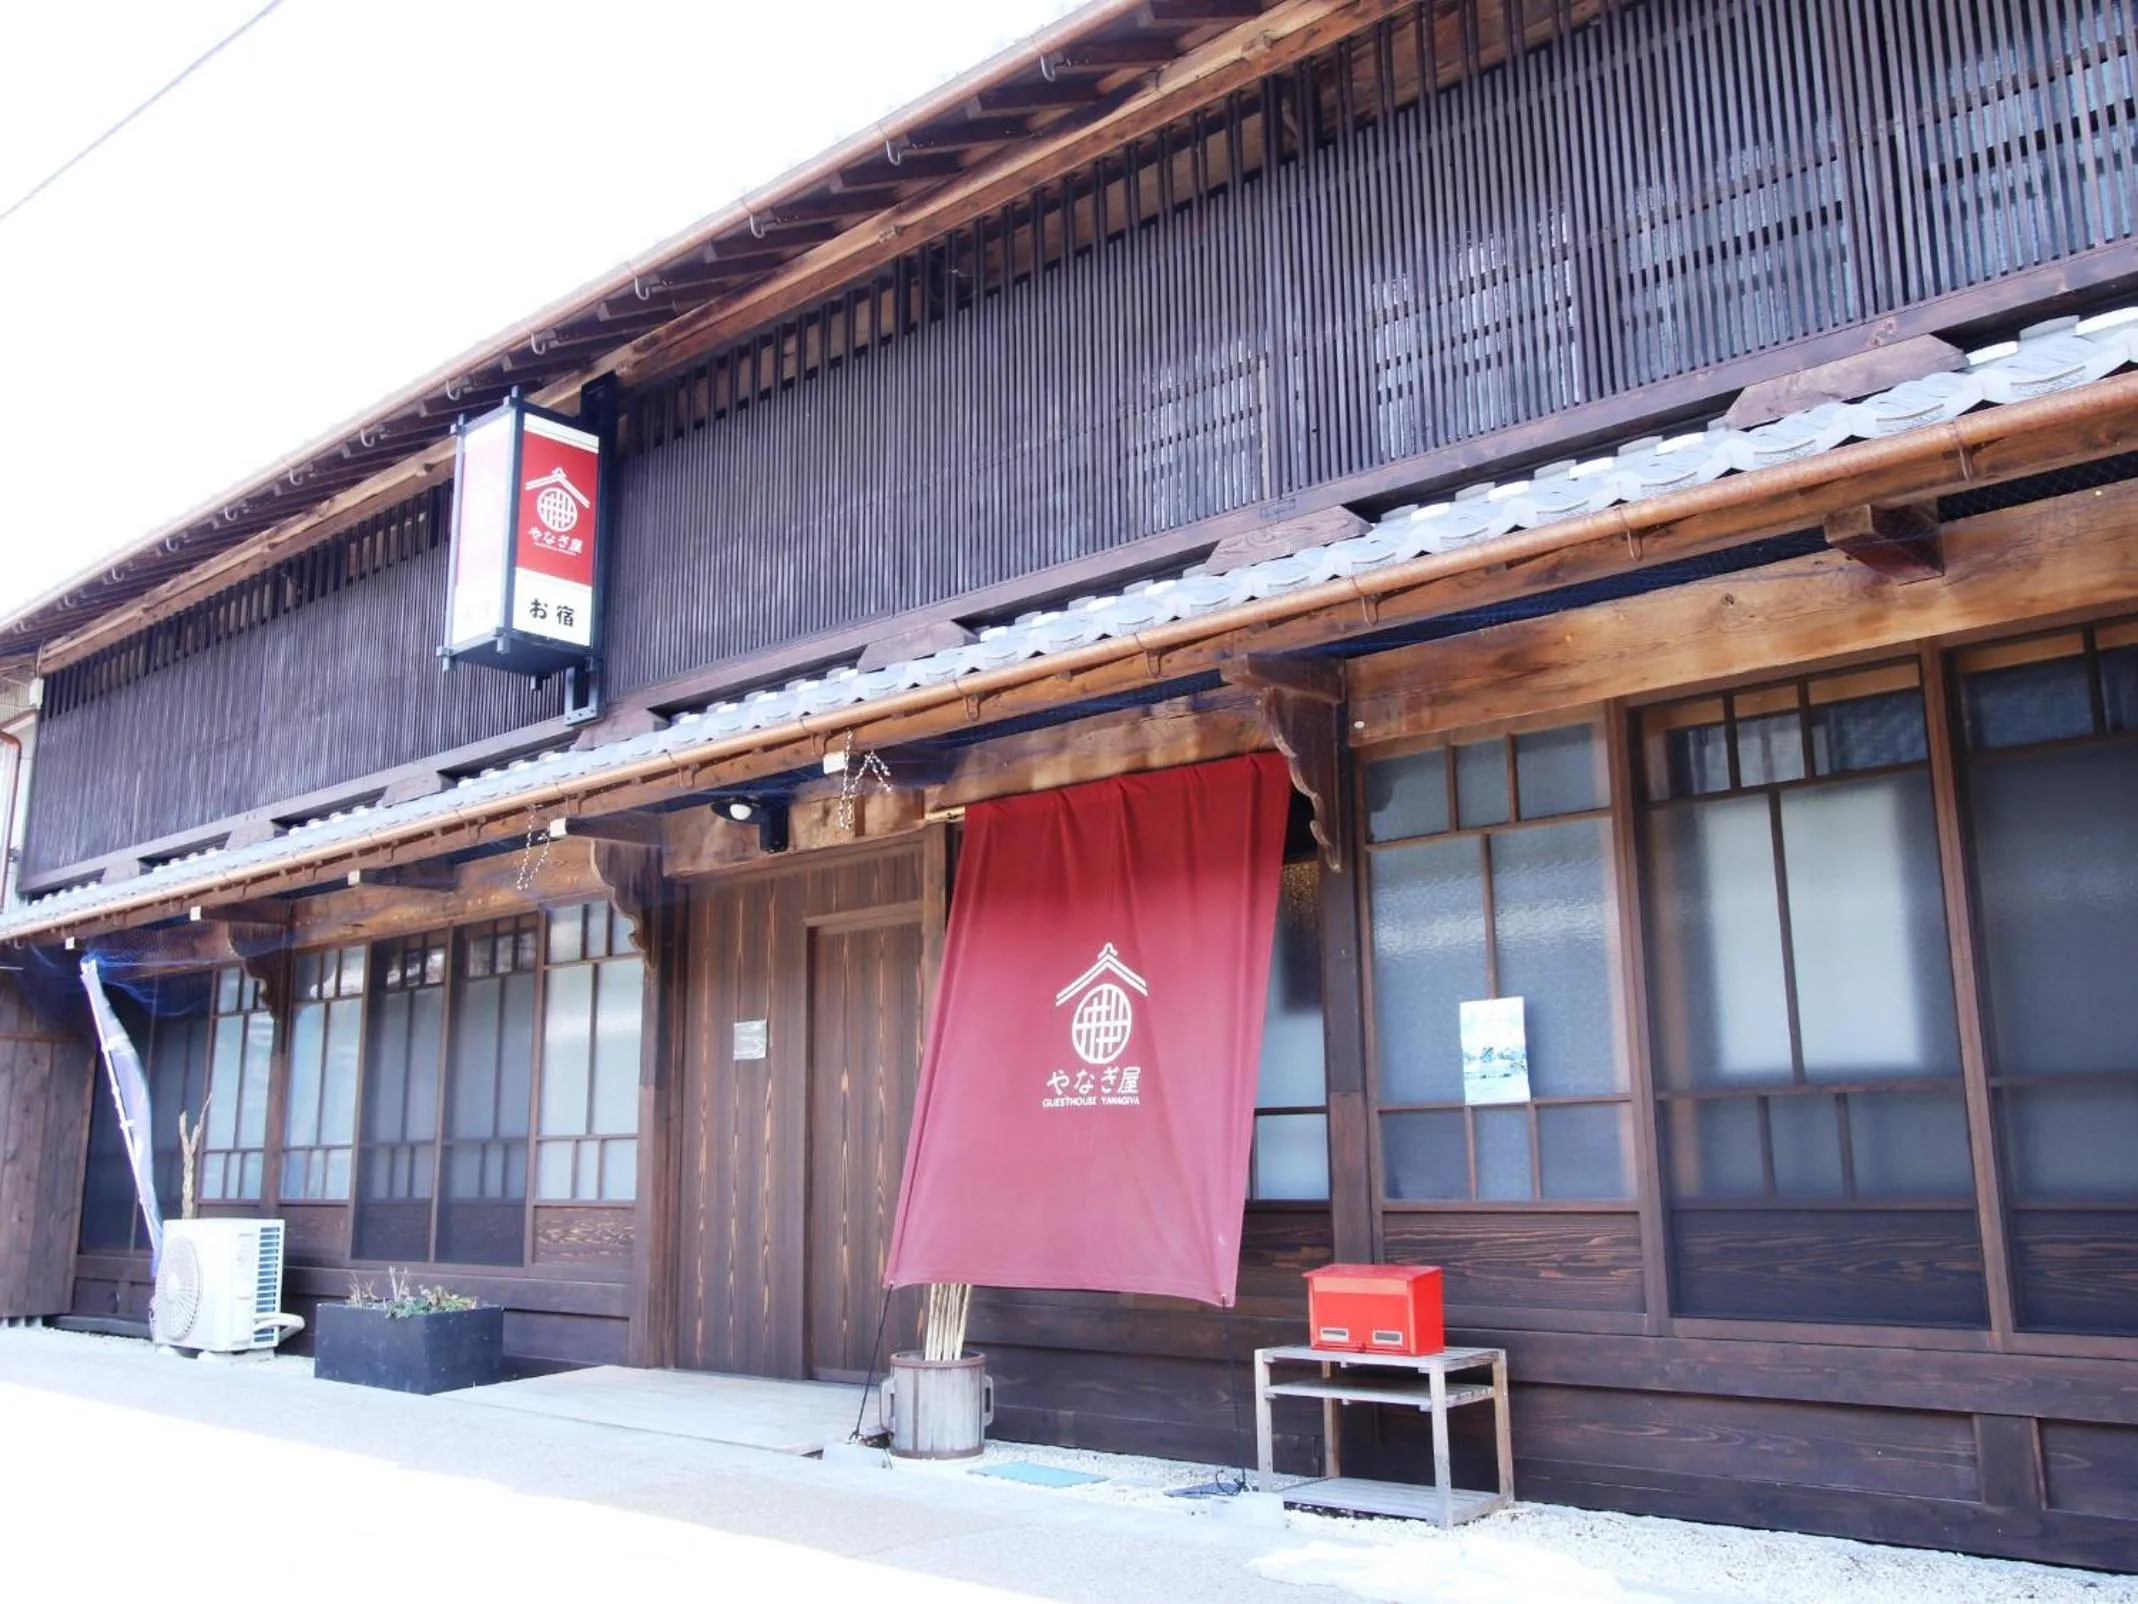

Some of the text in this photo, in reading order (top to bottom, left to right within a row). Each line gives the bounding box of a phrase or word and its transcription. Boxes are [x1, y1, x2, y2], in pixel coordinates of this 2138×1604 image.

[528, 527, 583, 553] やなぎ屋
[529, 598, 575, 628] お宿
[1046, 1066, 1141, 1095] やなぎ屋
[1042, 1096, 1140, 1108] GUESTHOUSE YANAGIYA
